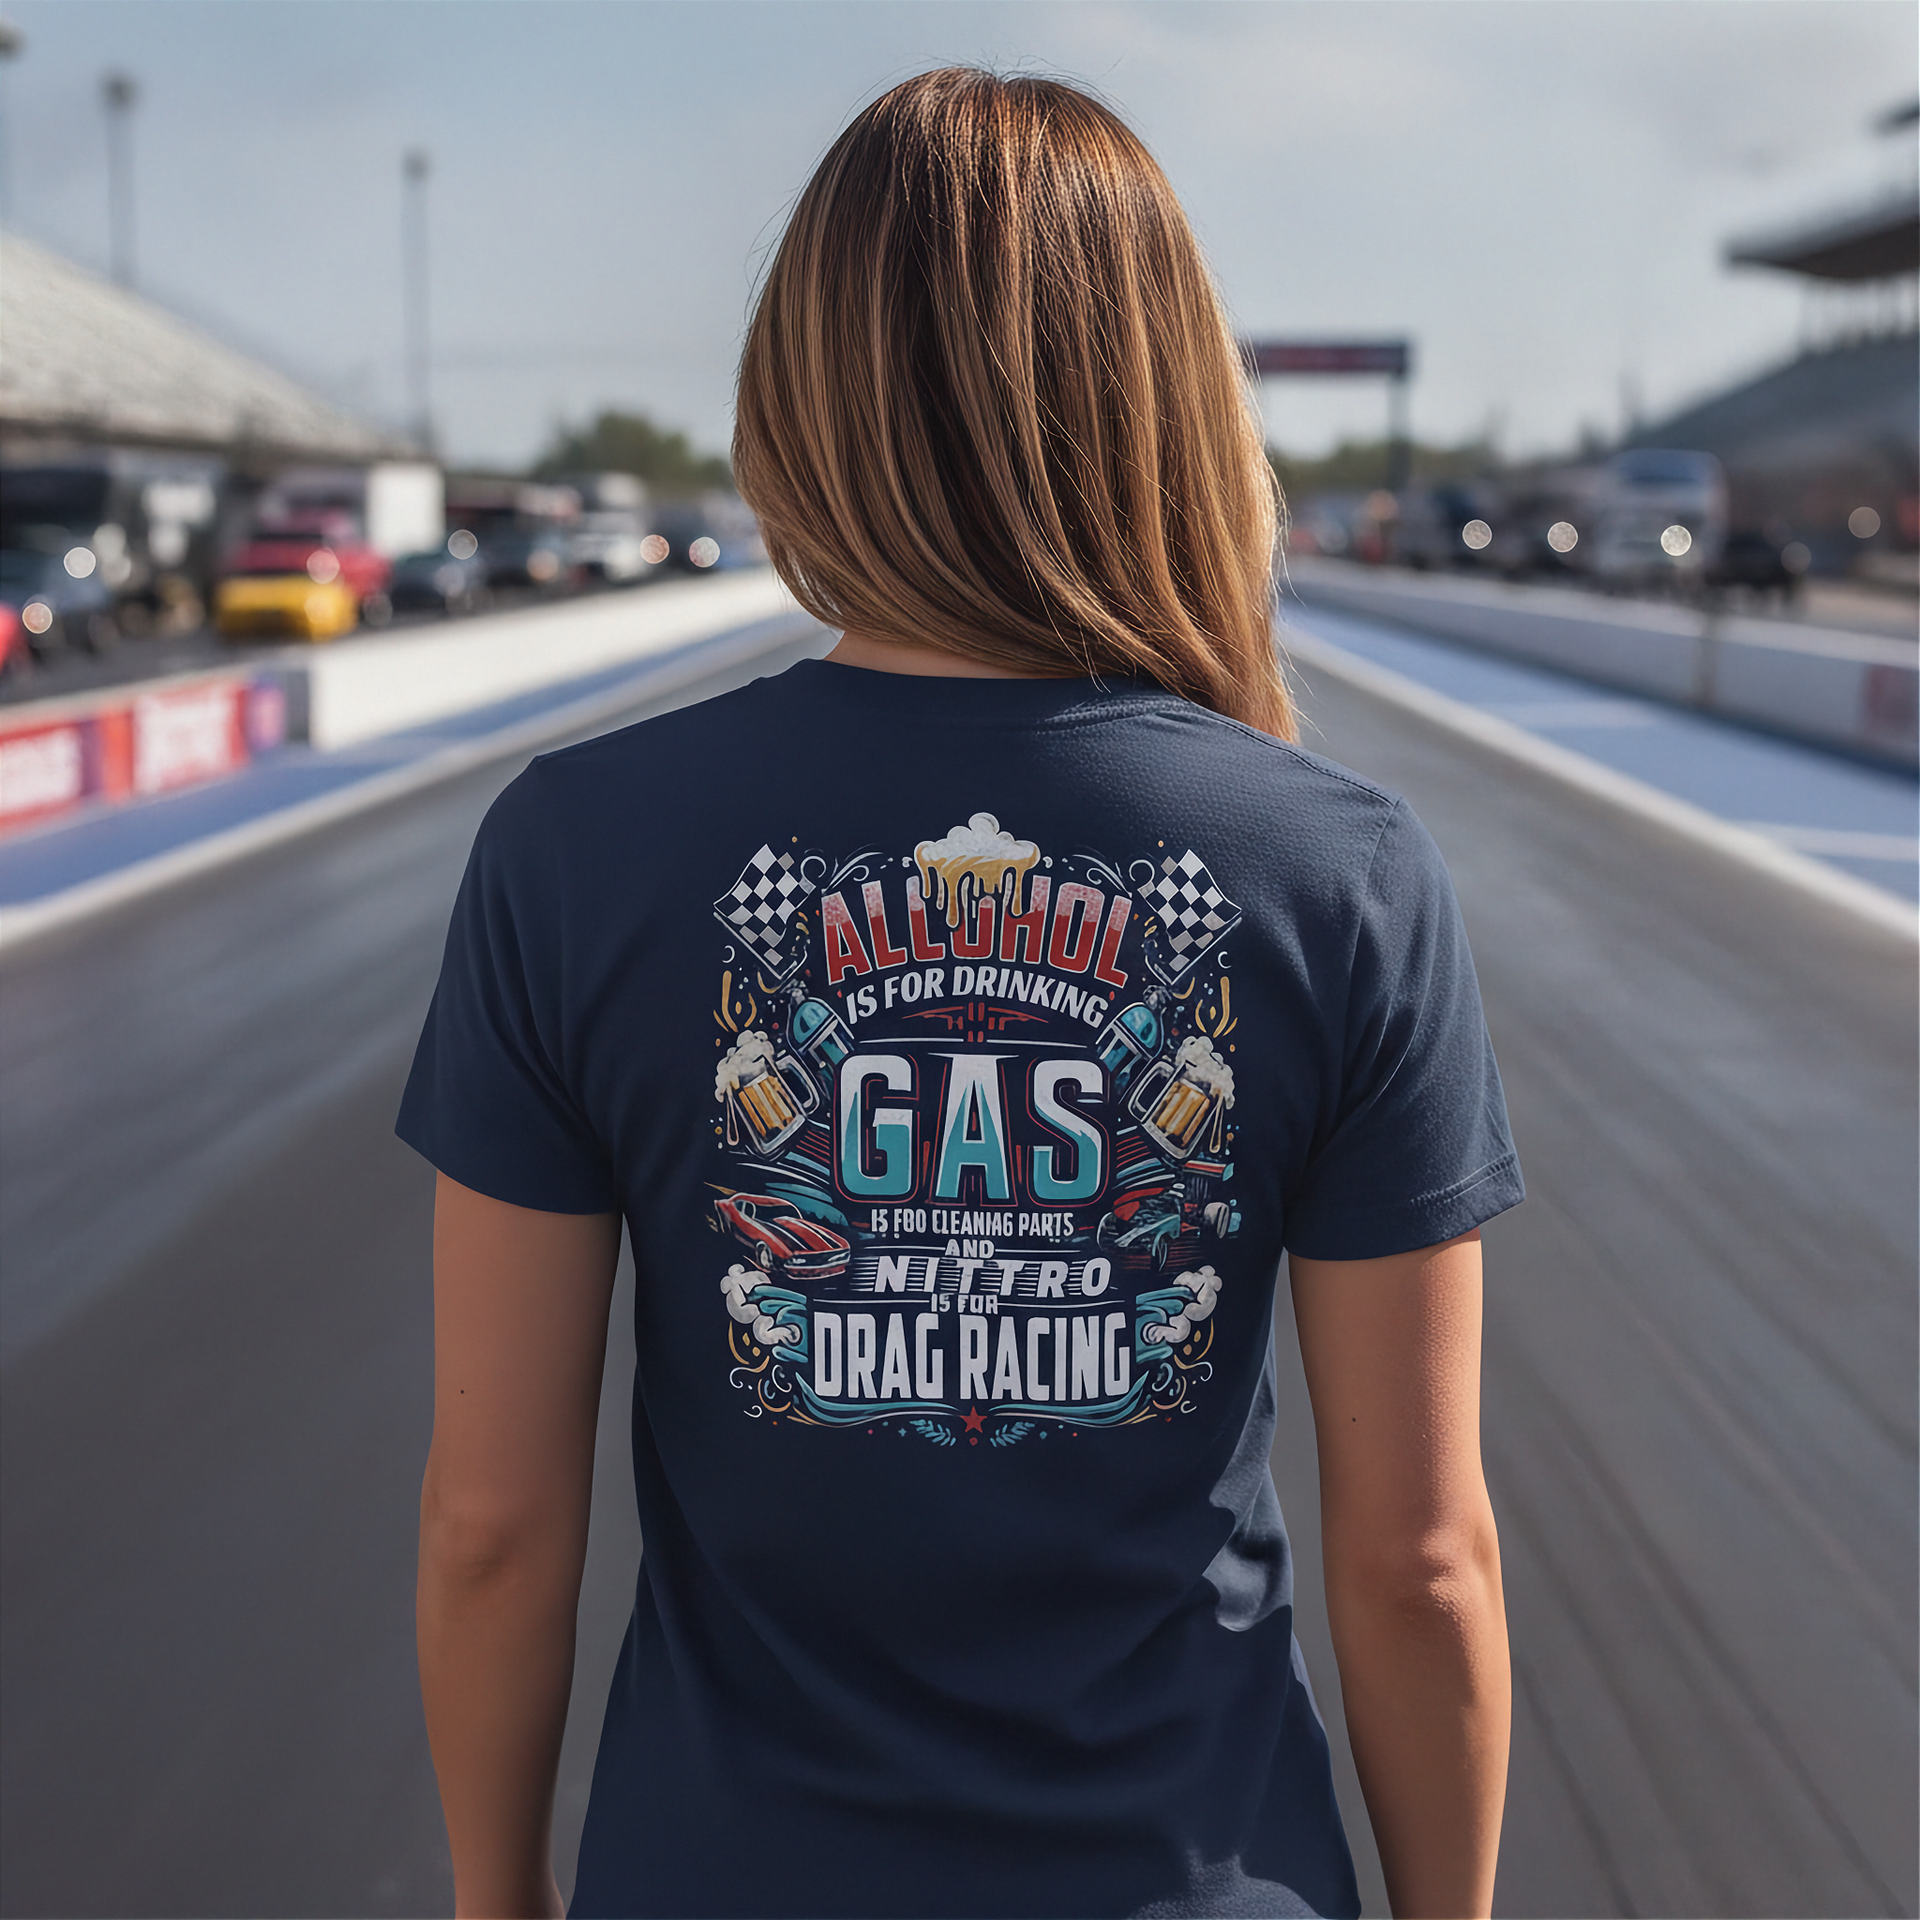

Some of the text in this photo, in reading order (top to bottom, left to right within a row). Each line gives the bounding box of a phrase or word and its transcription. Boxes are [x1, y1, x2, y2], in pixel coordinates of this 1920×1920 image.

[846, 965, 1110, 1029] IS FOR DRINKING
[840, 1052, 1104, 1201] GAS
[1018, 1211, 1075, 1237] PARTS
[945, 1238, 995, 1259] AND
[873, 1255, 1112, 1299] NITTRO
[931, 1293, 998, 1315] IS FOR
[813, 1311, 1131, 1402] DRAG RACING
